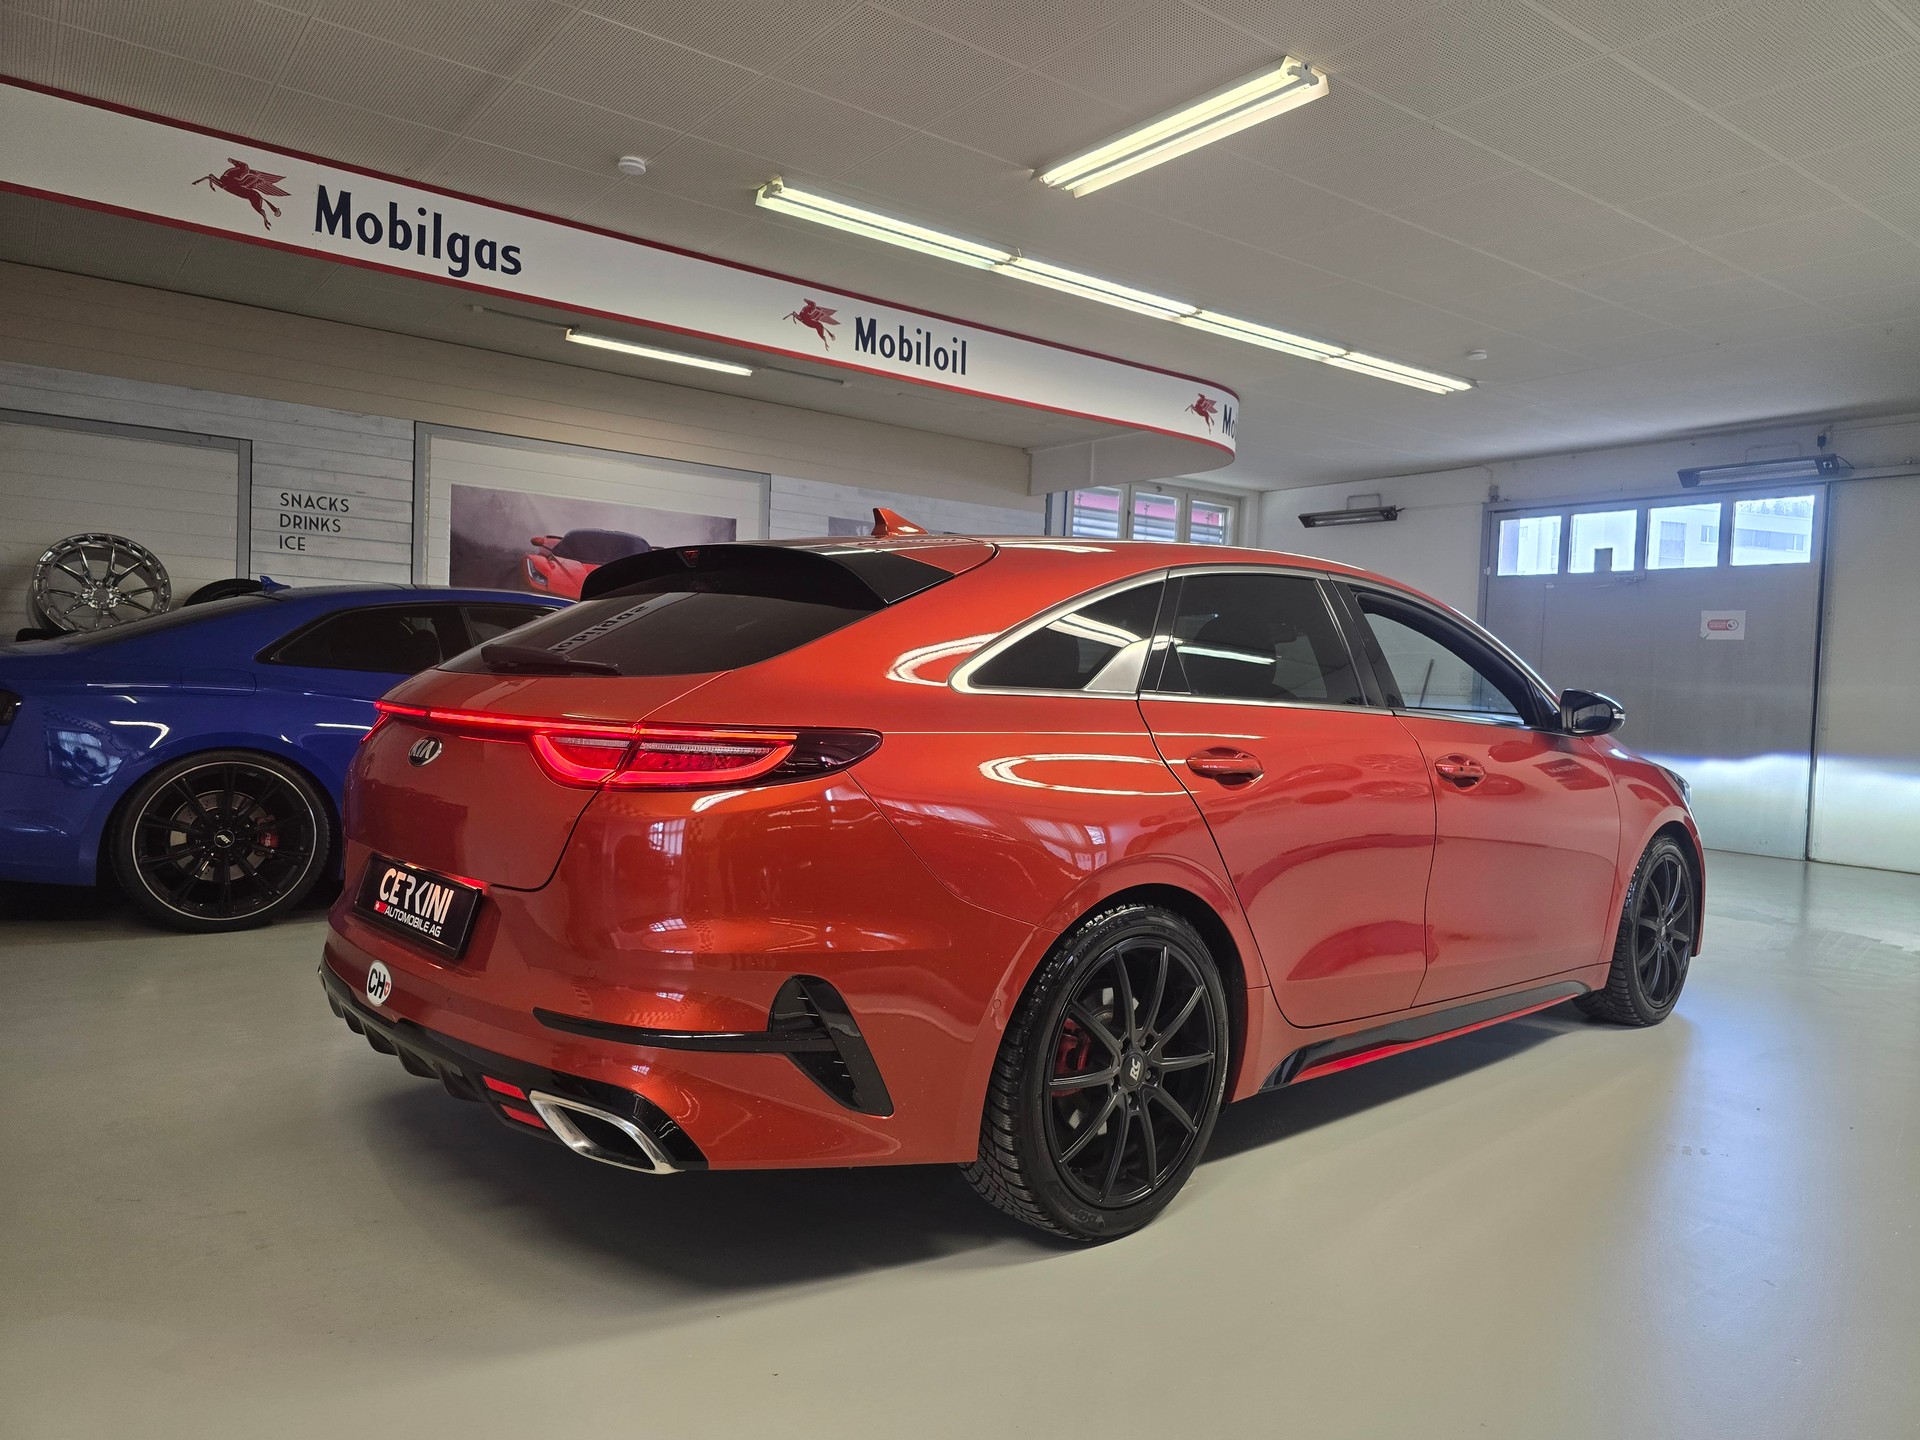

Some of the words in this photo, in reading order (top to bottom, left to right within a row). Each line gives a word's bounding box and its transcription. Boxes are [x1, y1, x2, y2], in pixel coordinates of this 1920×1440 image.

[315, 184, 522, 278] Mobilgas
[855, 316, 967, 376] Mobiloil
[1222, 404, 1237, 440] Mo
[280, 492, 350, 513] SNACKS
[280, 513, 341, 533] DRINKS
[279, 534, 306, 552] ICE
[410, 738, 437, 760] KIA
[379, 867, 455, 925] CERKINI
[384, 905, 431, 933] AUTOMOBILE
[428, 925, 442, 938] AG
[368, 968, 386, 999] CH
[1130, 1057, 1141, 1081] RC
